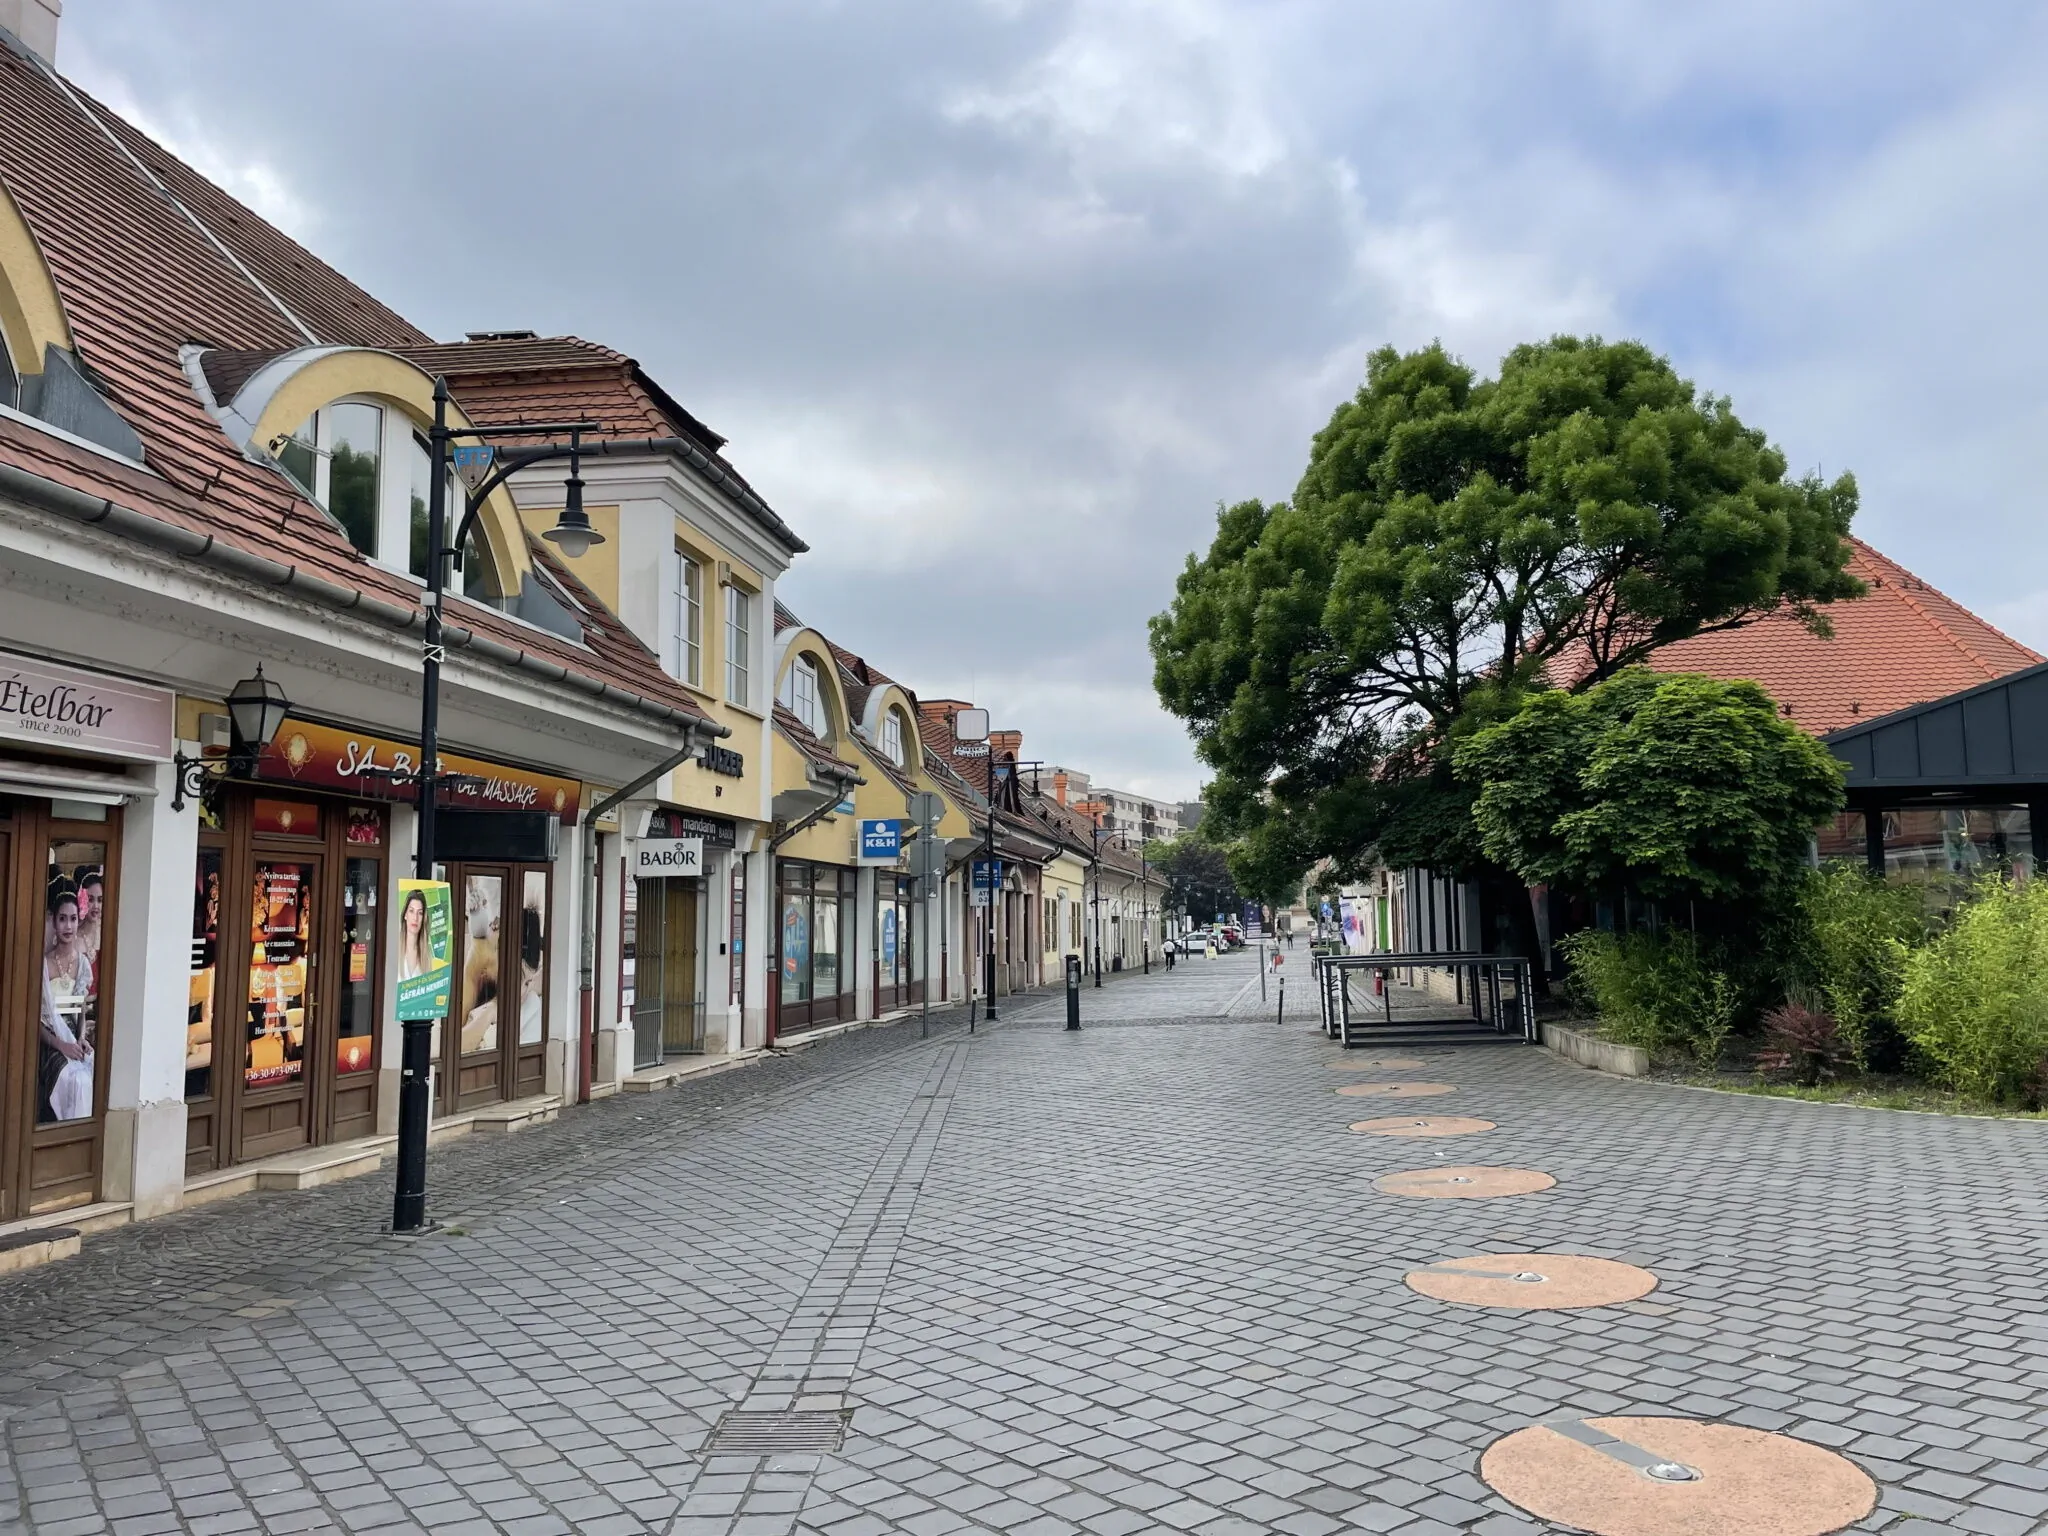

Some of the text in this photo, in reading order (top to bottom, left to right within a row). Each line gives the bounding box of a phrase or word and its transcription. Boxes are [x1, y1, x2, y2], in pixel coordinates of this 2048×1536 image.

[0, 673, 113, 728] Ételbár
[19, 717, 81, 738] since 2000
[482, 776, 539, 810] MASSAGE
[683, 817, 716, 834] mandarin
[865, 838, 896, 848] K&H
[640, 850, 697, 866] BABOR
